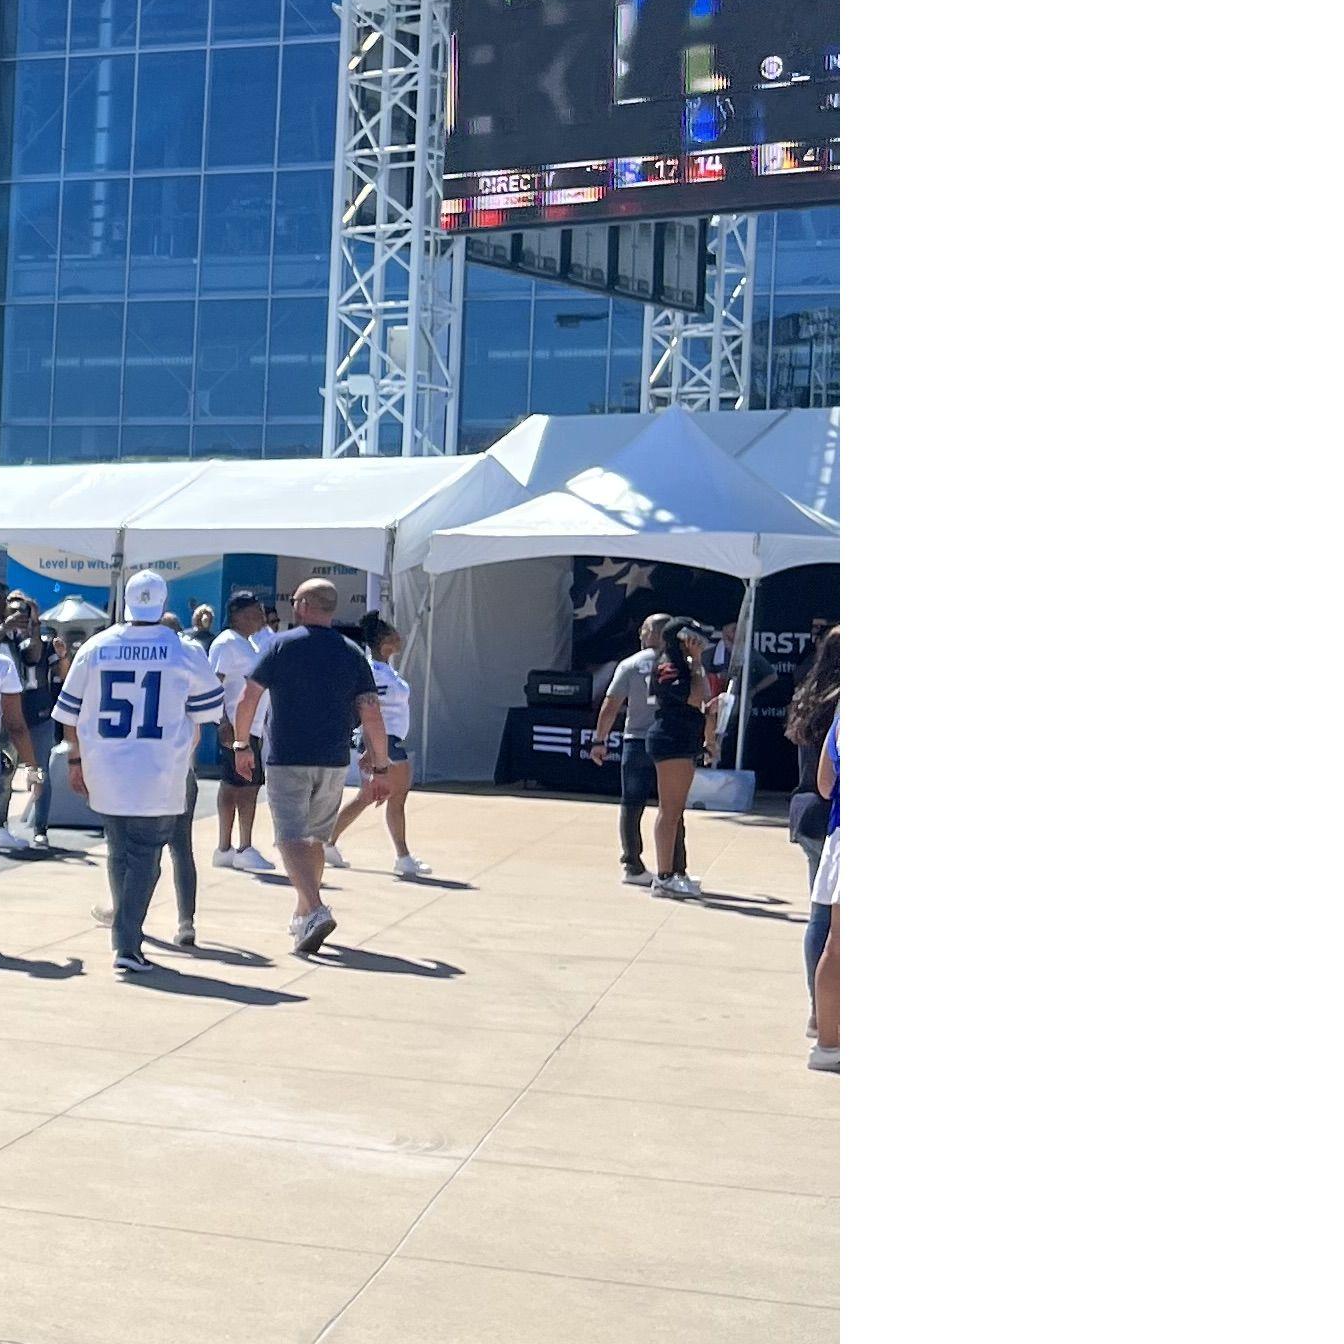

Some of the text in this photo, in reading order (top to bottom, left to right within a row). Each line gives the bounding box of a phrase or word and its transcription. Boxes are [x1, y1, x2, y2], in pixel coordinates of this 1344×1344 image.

[39, 557, 68, 570] Level
[70, 559, 85, 572] up
[114, 646, 168, 661] JORDAN
[98, 670, 163, 739] 51
